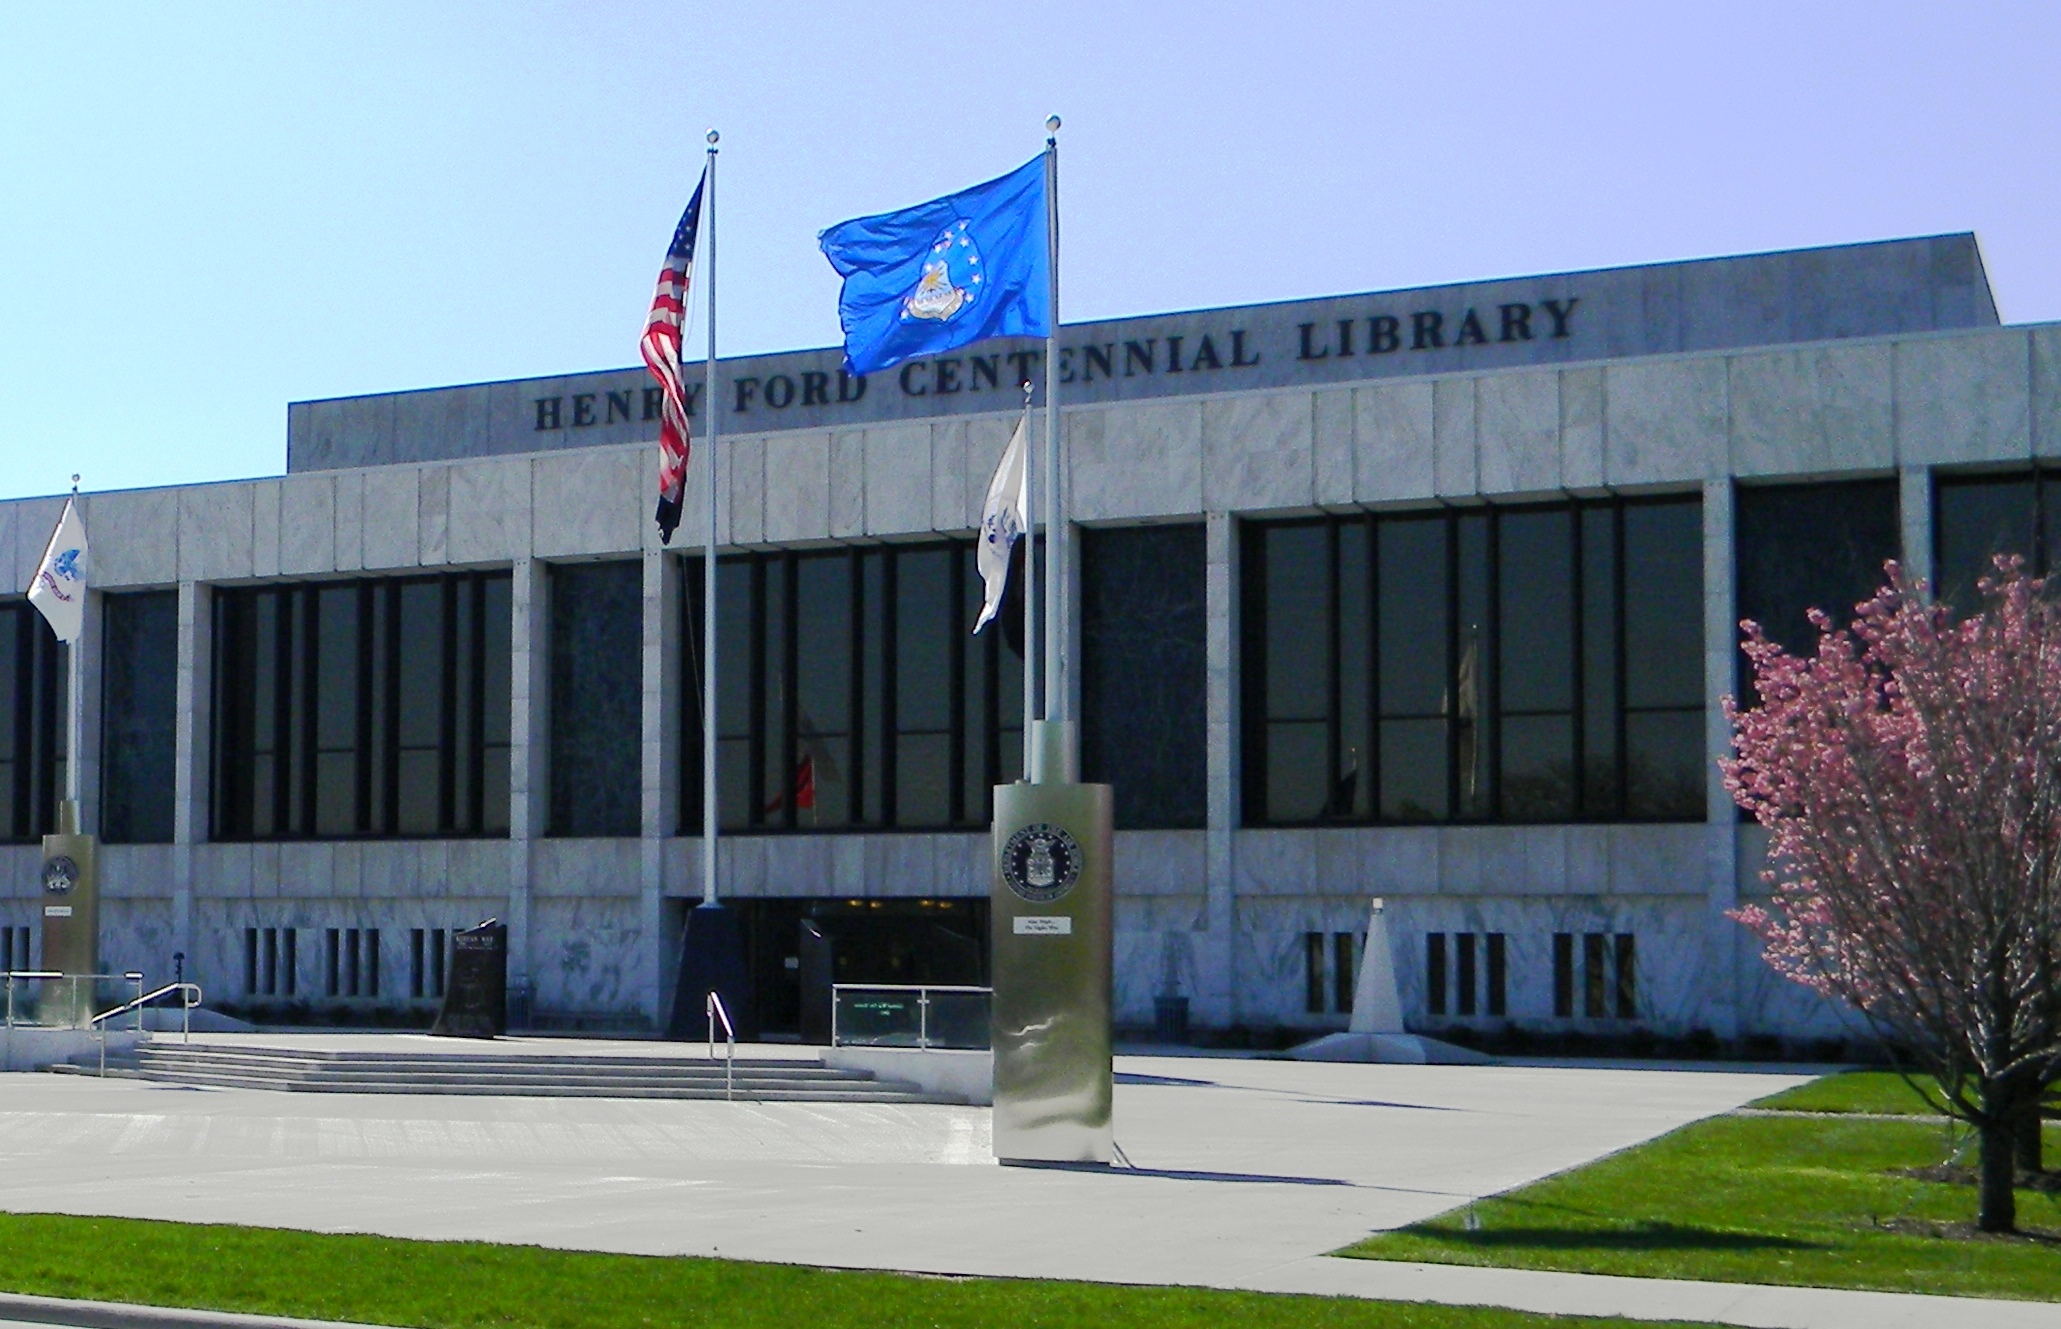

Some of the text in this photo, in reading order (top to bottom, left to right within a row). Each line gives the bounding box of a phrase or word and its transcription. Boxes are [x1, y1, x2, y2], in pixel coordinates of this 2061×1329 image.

[733, 368, 867, 413] FORD
[899, 330, 1259, 397] CENTENNIAL
[1296, 299, 1578, 361] LIBRARY
